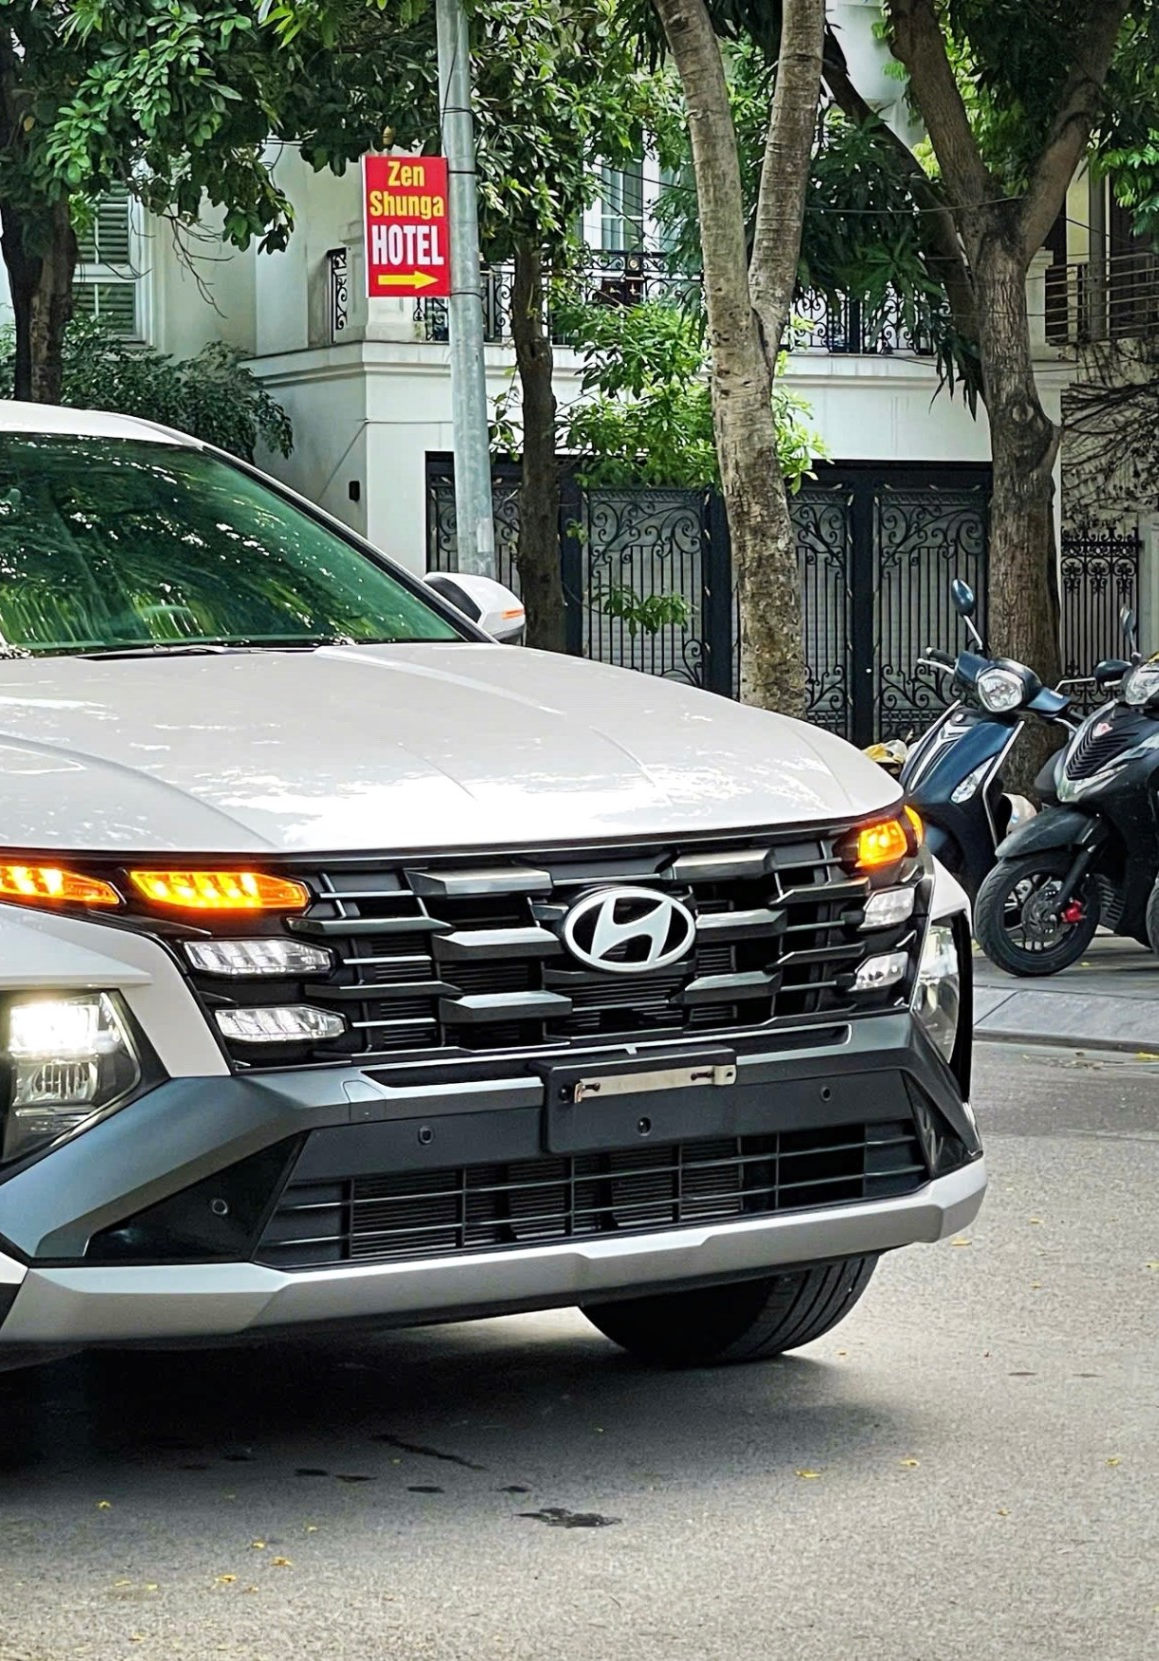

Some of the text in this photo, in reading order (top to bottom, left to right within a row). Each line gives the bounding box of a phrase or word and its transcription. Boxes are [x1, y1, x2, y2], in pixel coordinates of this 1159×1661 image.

[388, 161, 425, 187] Zen
[370, 191, 445, 220] Shunga
[372, 224, 444, 265] HOTEL
